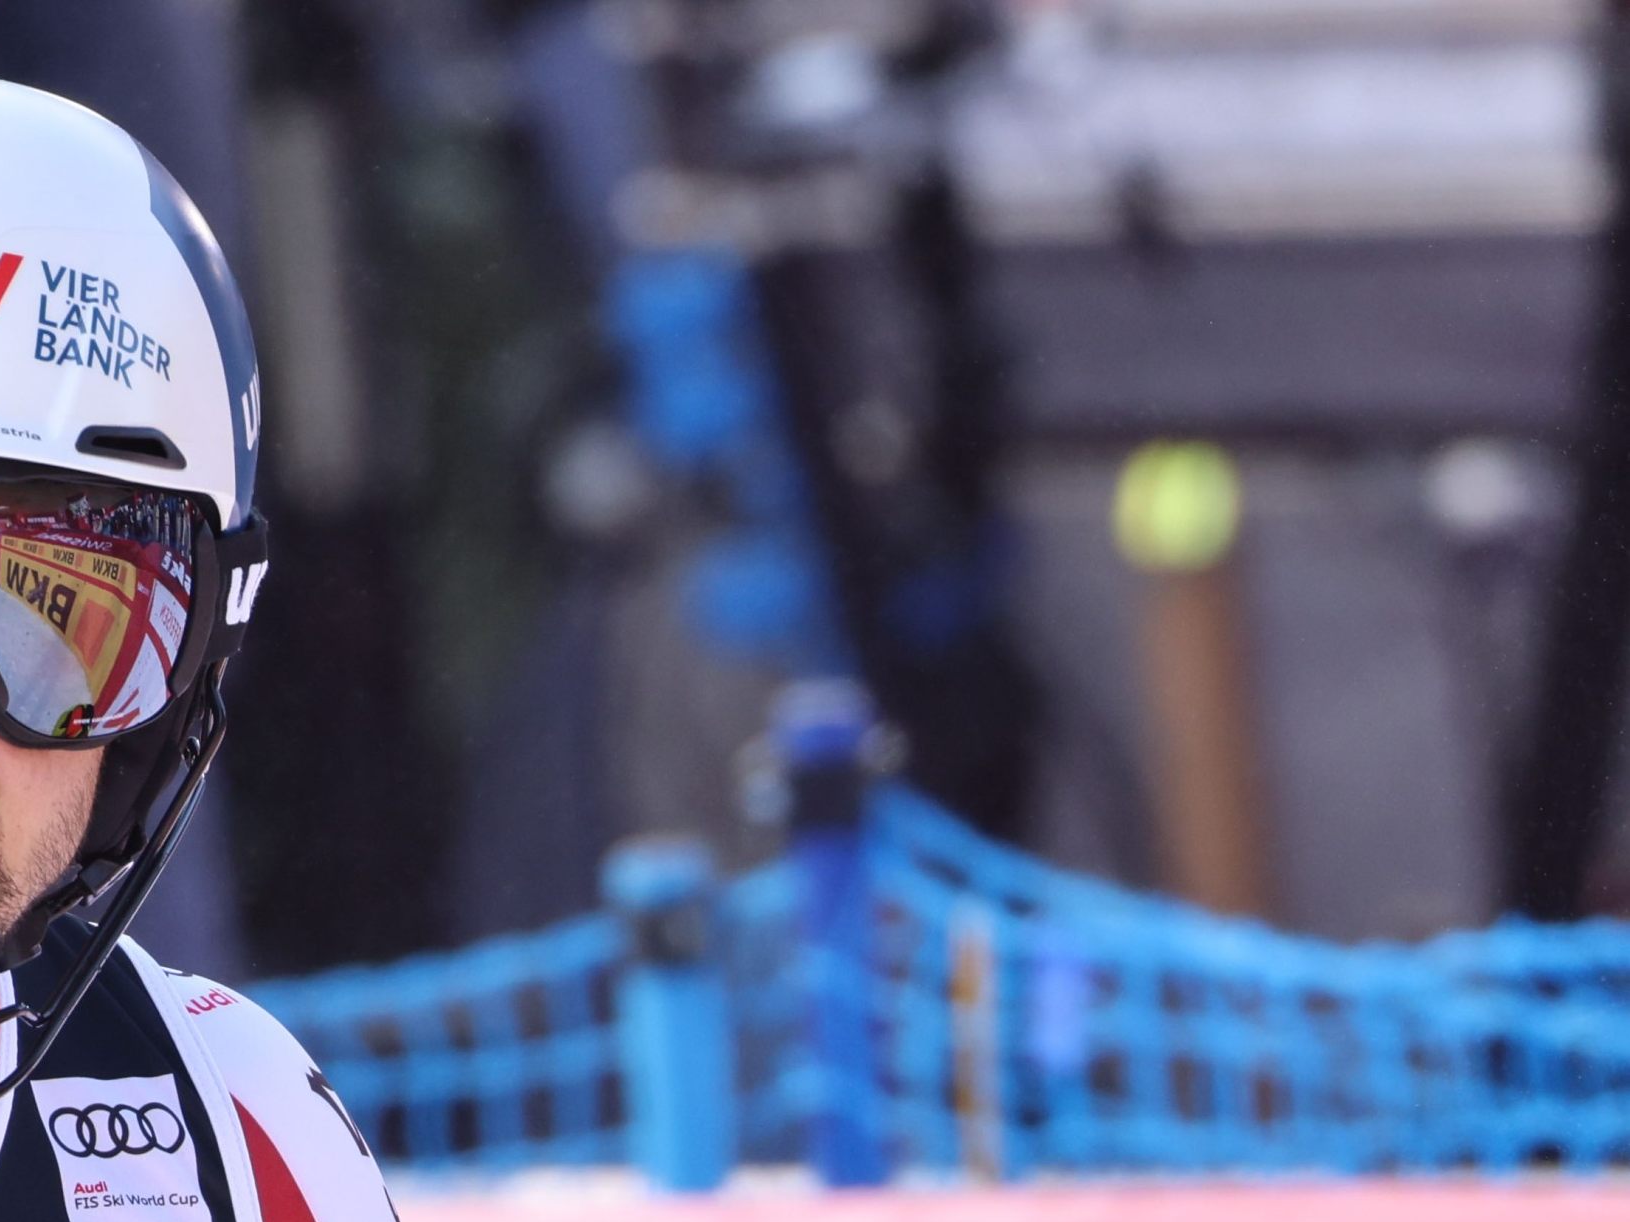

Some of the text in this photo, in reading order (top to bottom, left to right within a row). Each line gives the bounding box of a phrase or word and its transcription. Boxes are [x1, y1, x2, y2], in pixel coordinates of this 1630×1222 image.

[40, 260, 121, 314] VIER
[34, 328, 133, 390] BANK
[38, 293, 171, 382] LÄNDER
[73, 1181, 108, 1195] Audi
[74, 1193, 199, 1210] FIS Ski World Cup
